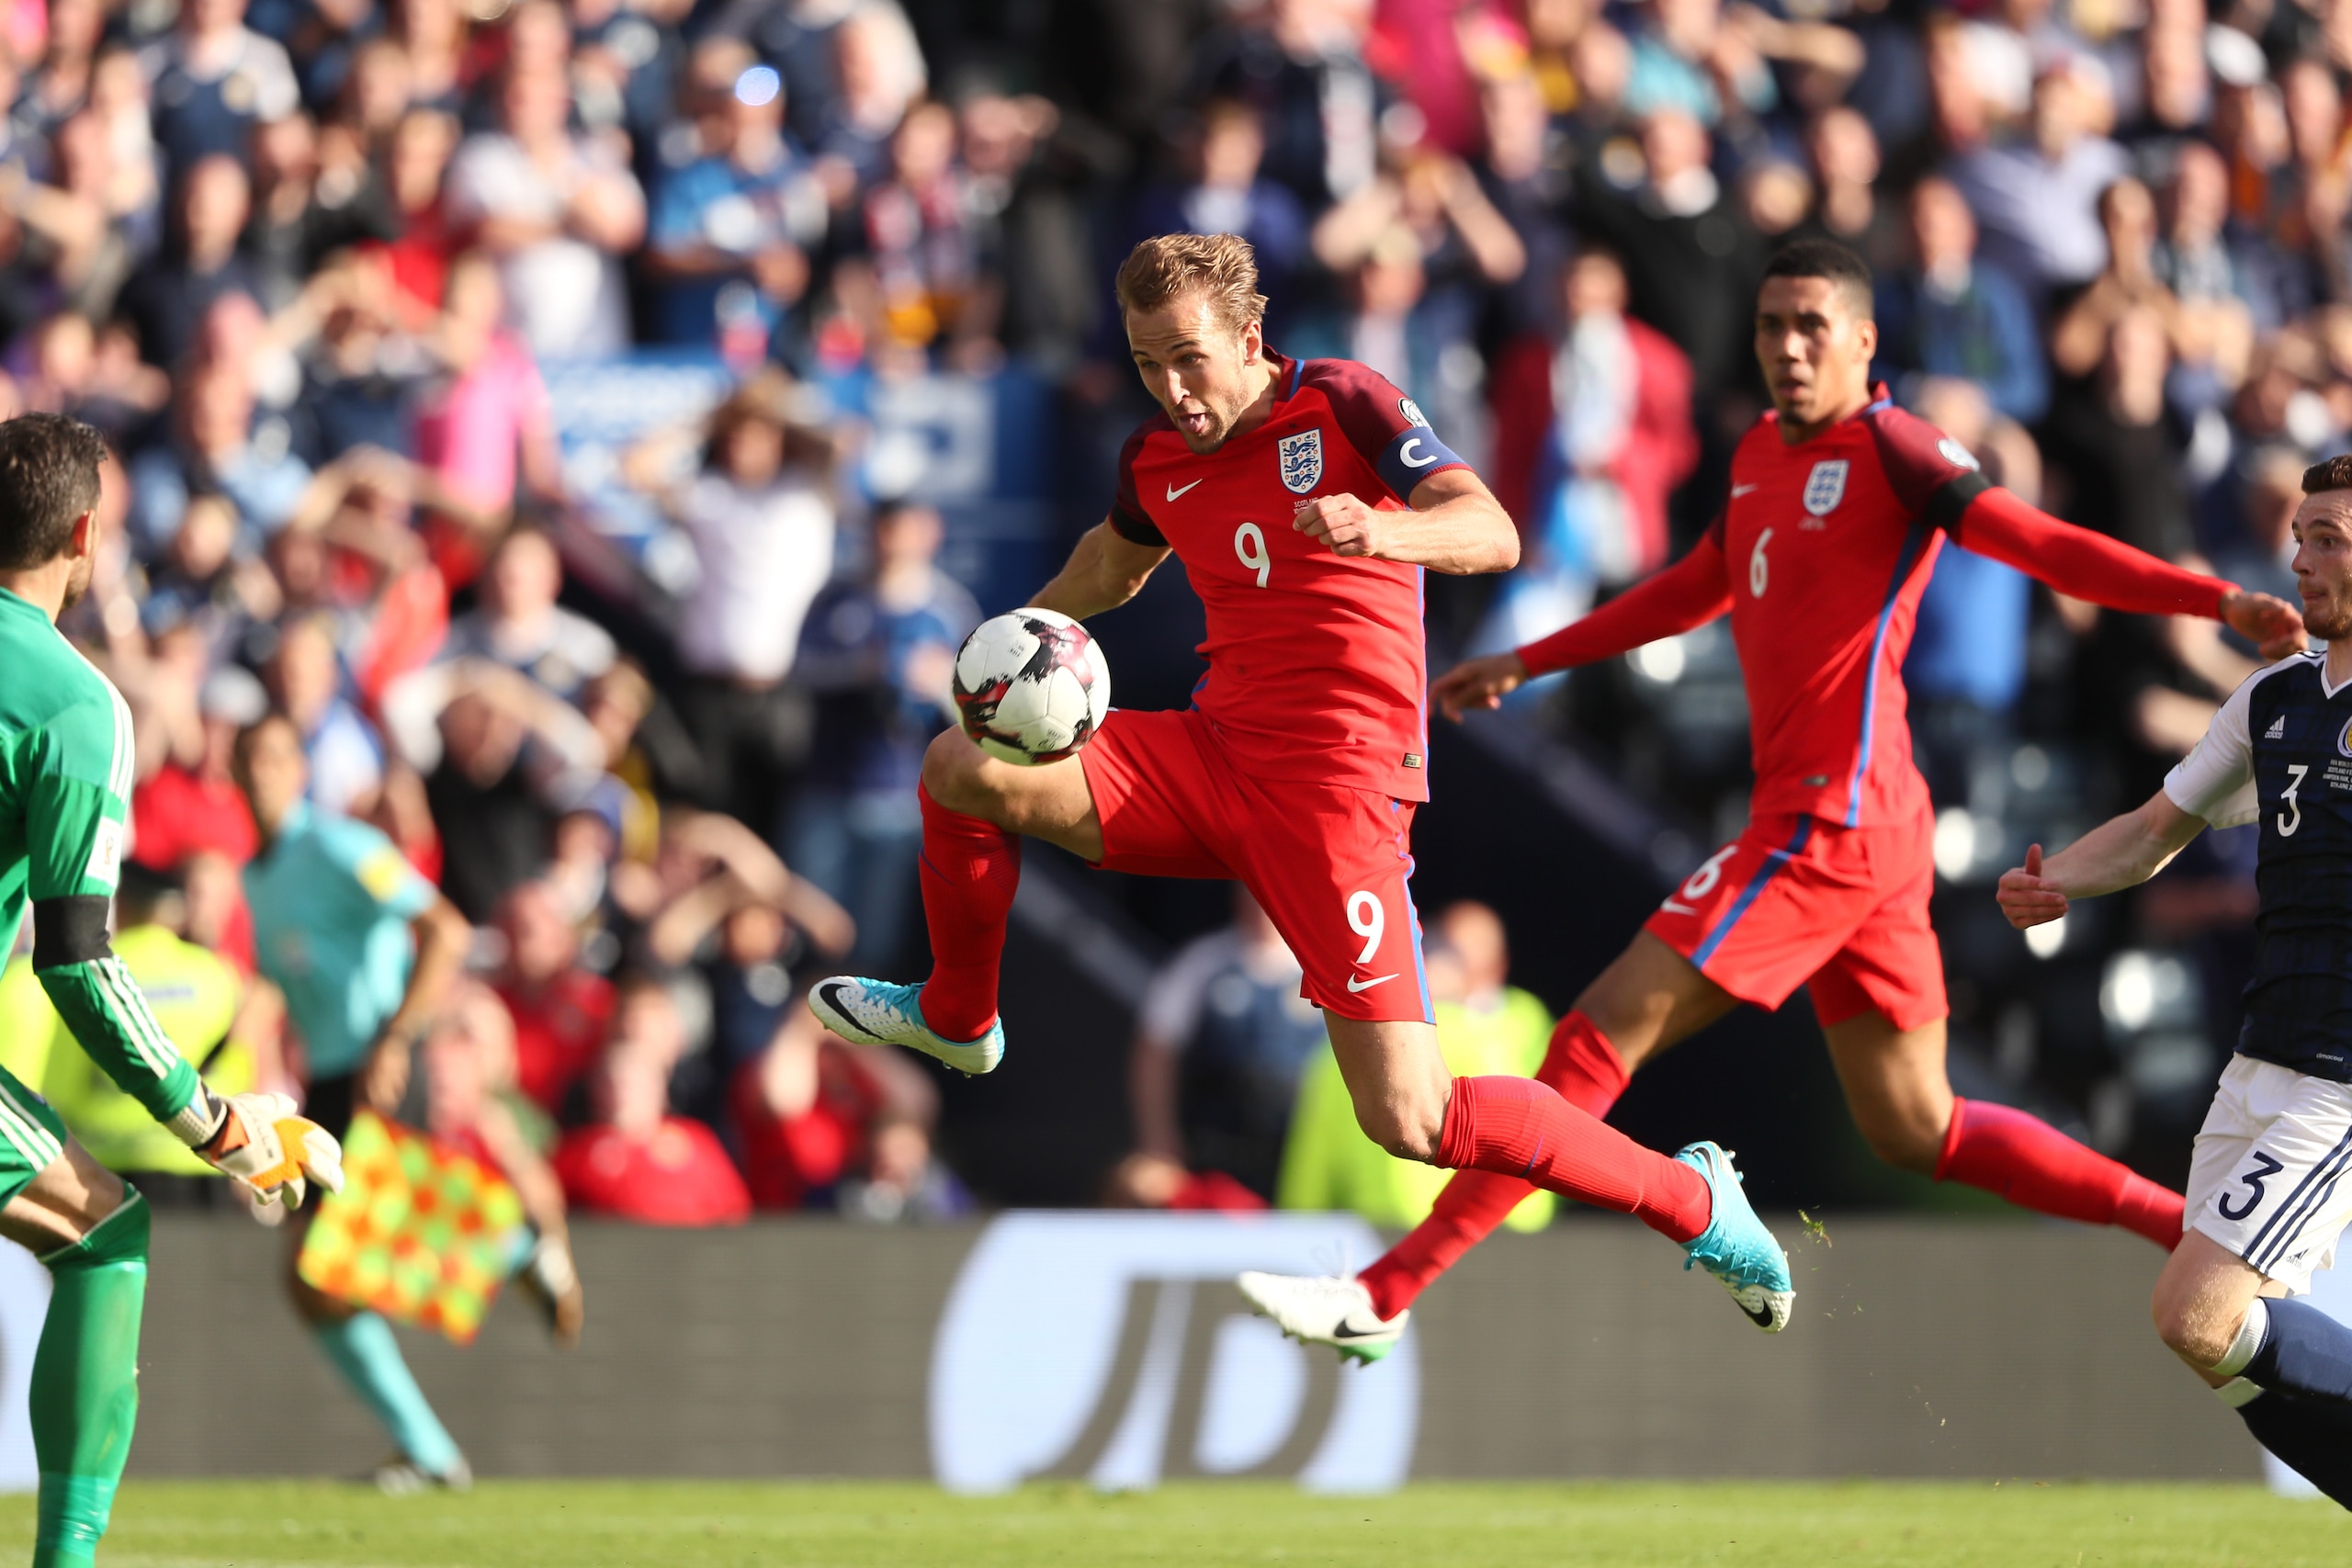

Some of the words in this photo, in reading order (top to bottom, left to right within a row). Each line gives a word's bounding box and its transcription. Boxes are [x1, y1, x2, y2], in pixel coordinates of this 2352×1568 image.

[1399, 437, 1439, 468] C
[1234, 522, 1271, 588] 9
[1749, 527, 1773, 598] 6
[2277, 763, 2309, 837] 3
[1682, 844, 1737, 900] 6
[1346, 890, 1385, 964] 9
[2218, 1150, 2284, 1221] 3
[1012, 1277, 1342, 1481] JD
